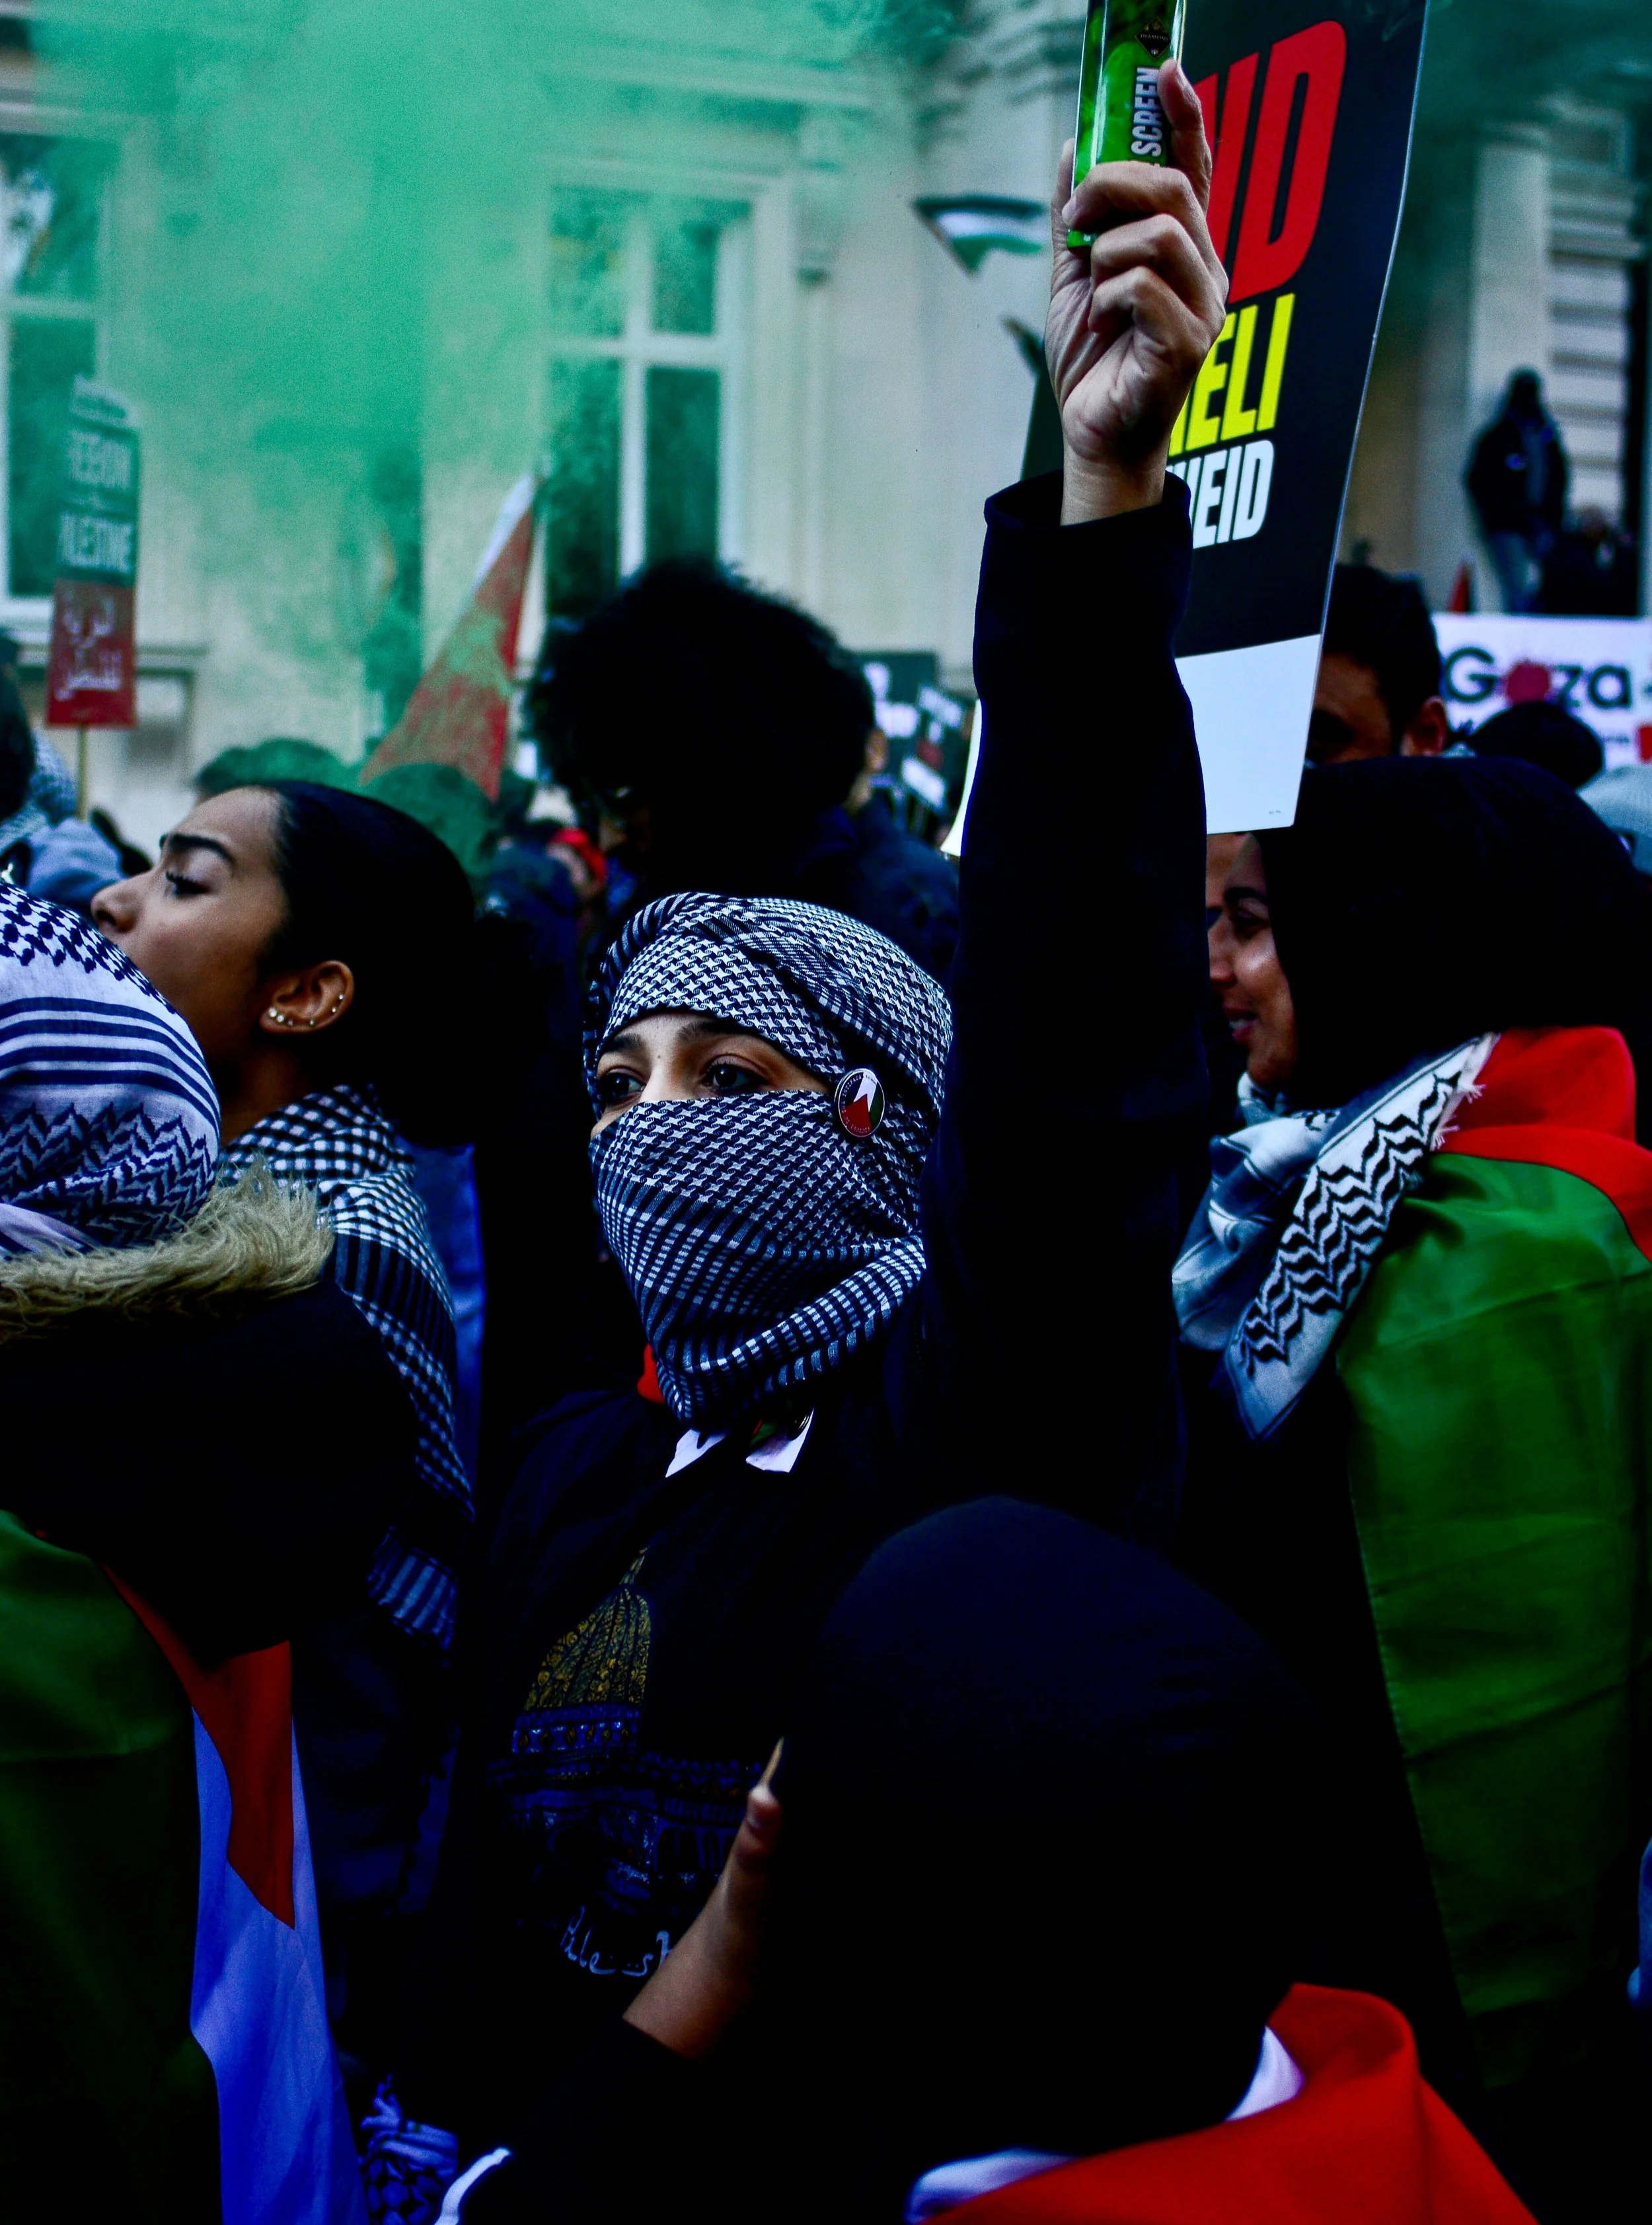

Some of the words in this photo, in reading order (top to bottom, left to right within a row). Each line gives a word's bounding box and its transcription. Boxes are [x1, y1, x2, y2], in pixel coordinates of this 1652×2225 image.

[1131, 67, 1163, 157] SCREEN
[1191, 20, 1347, 305] ND
[1168, 293, 1295, 457] ELI
